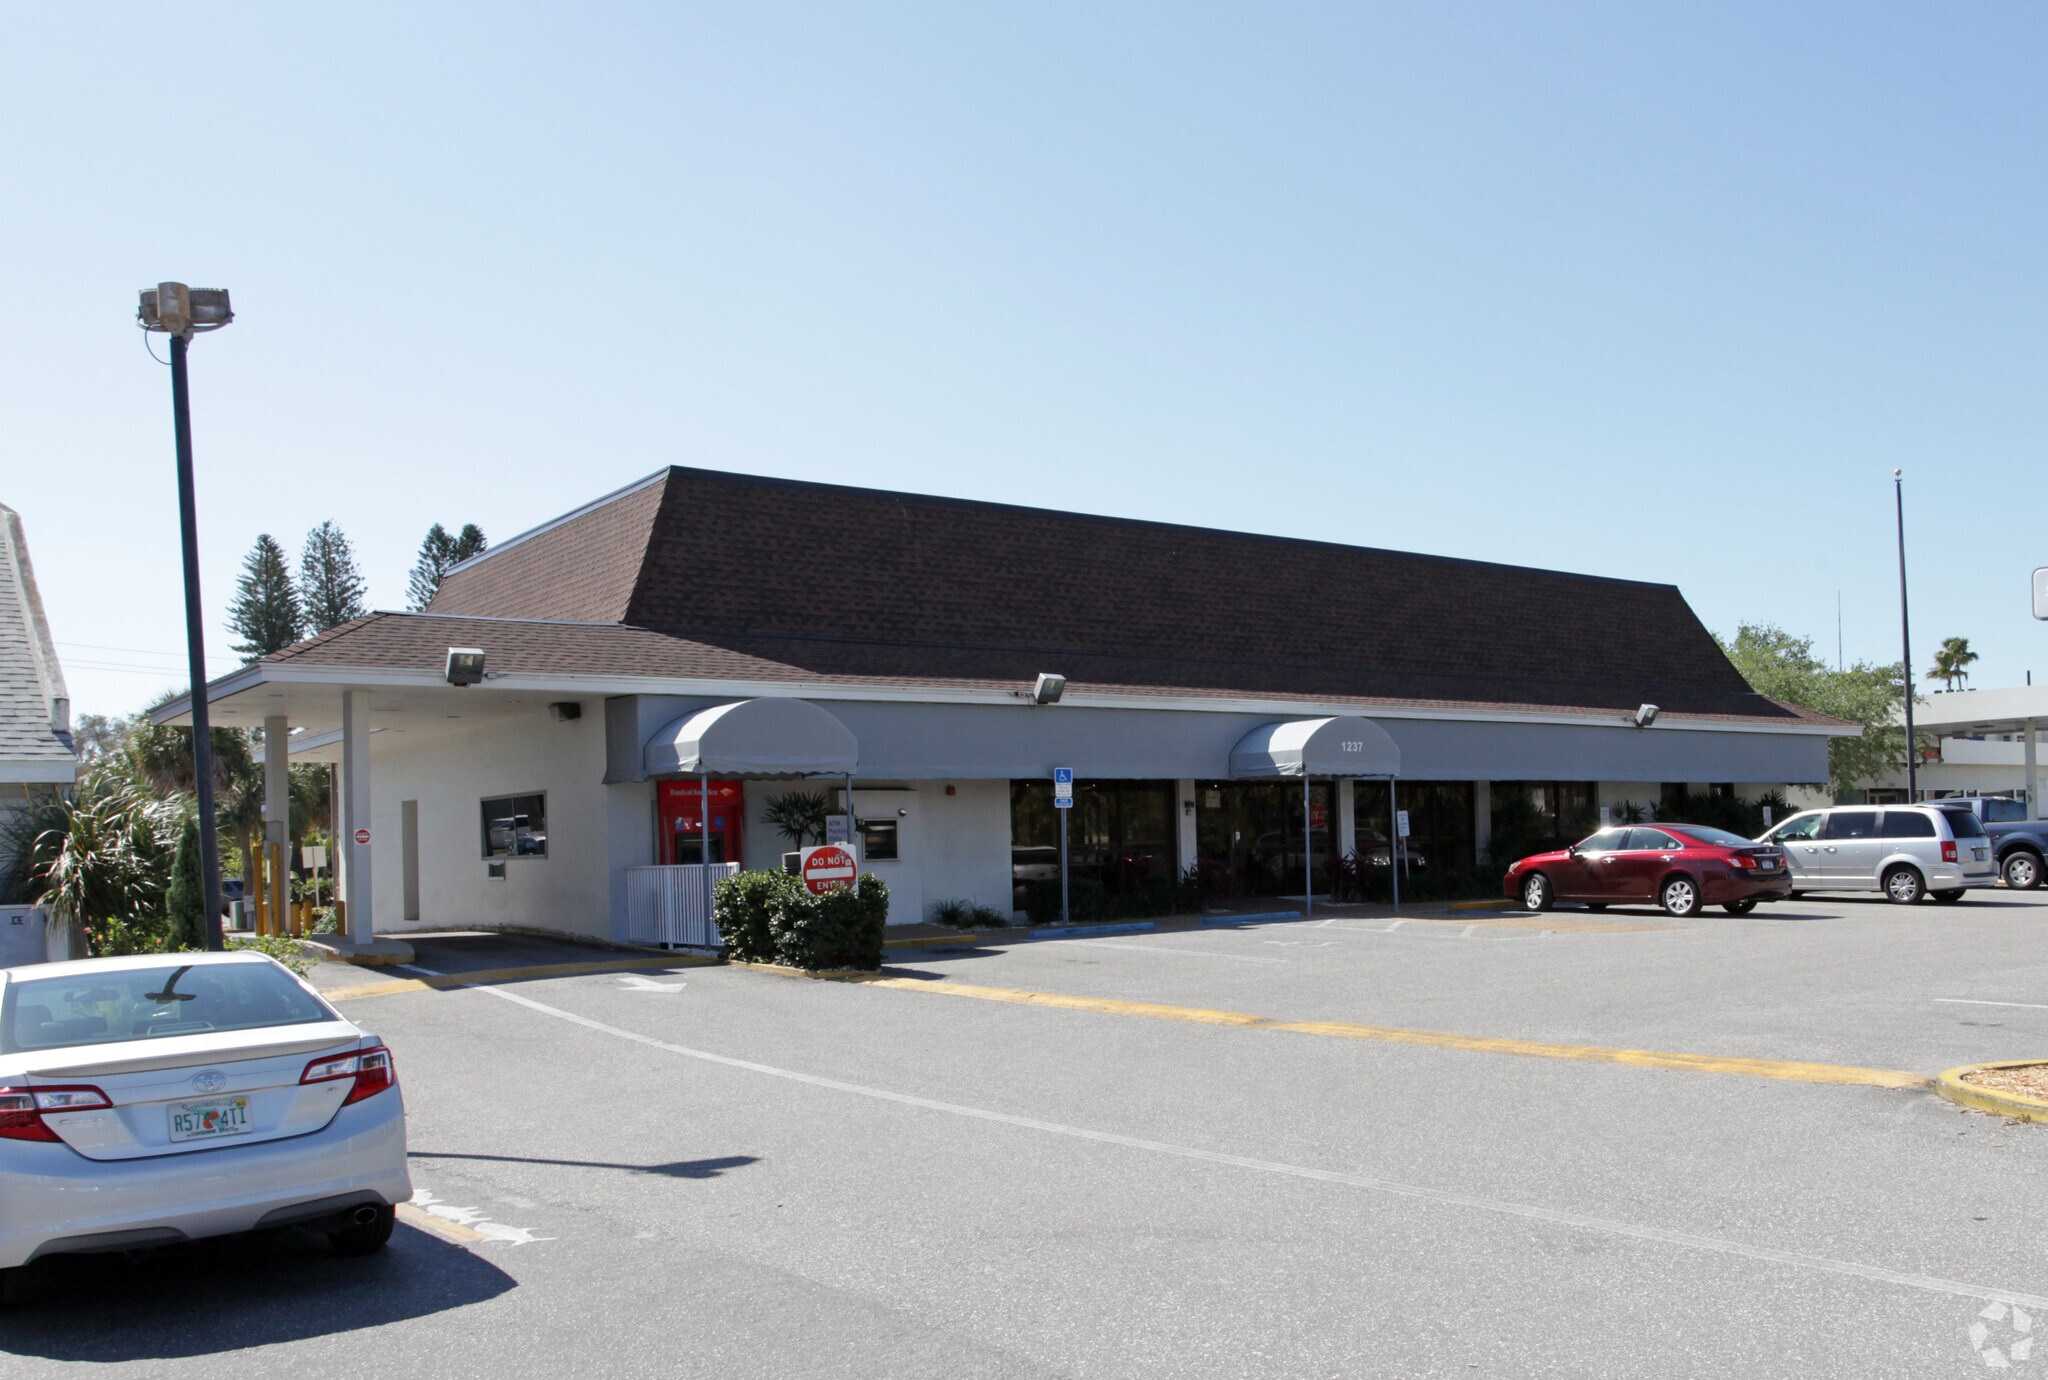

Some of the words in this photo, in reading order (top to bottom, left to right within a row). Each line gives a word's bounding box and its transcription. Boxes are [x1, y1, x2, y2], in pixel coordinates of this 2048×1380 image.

[1341, 741, 1363, 752] 1237
[693, 788, 718, 796] Amica
[812, 857, 825, 866] DO
[827, 856, 845, 865] NOT
[816, 880, 846, 890] ENTR
